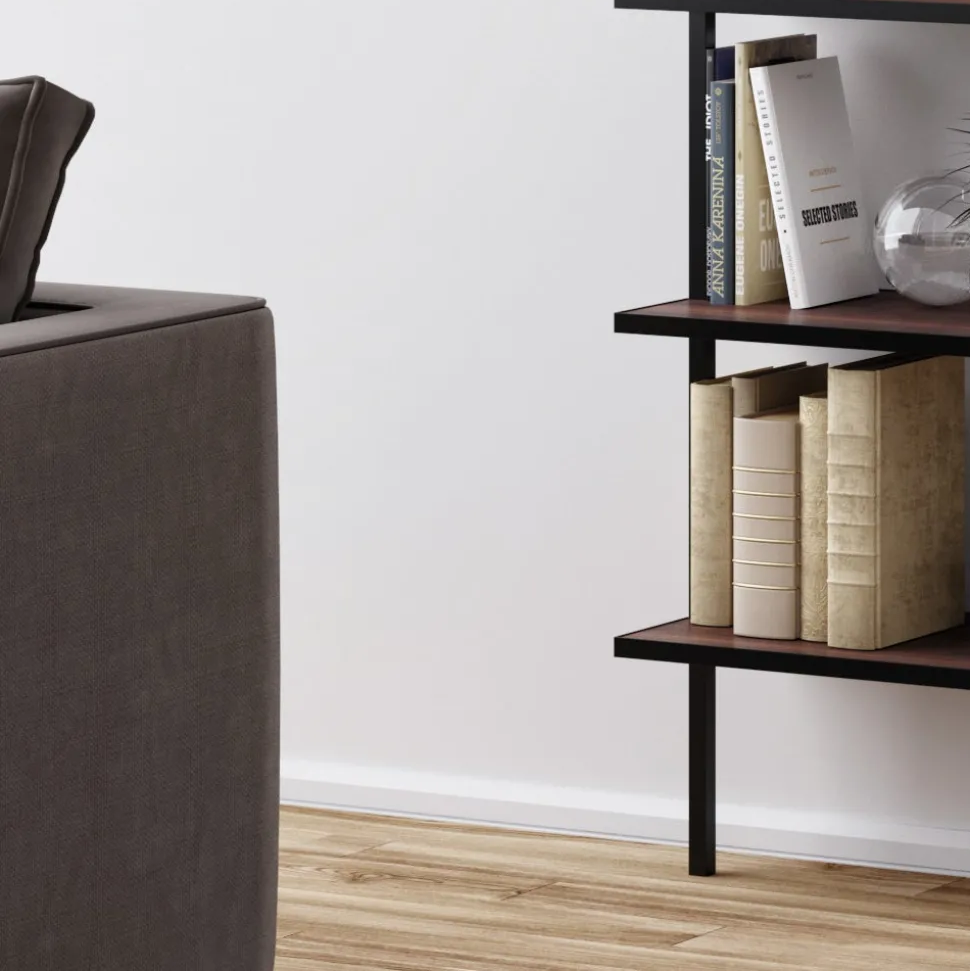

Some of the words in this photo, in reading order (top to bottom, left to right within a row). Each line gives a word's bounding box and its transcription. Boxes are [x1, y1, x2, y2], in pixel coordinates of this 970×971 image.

[757, 90, 774, 146] STORIES
[712, 155, 725, 243] KARENINA
[735, 174, 745, 232] ONEGIN
[769, 155, 786, 220] SELECTED
[801, 205, 832, 227] SELECTED
[831, 200, 859, 221] STORIES
[712, 247, 725, 299] ANNA
[735, 236, 745, 296] EUGENE
